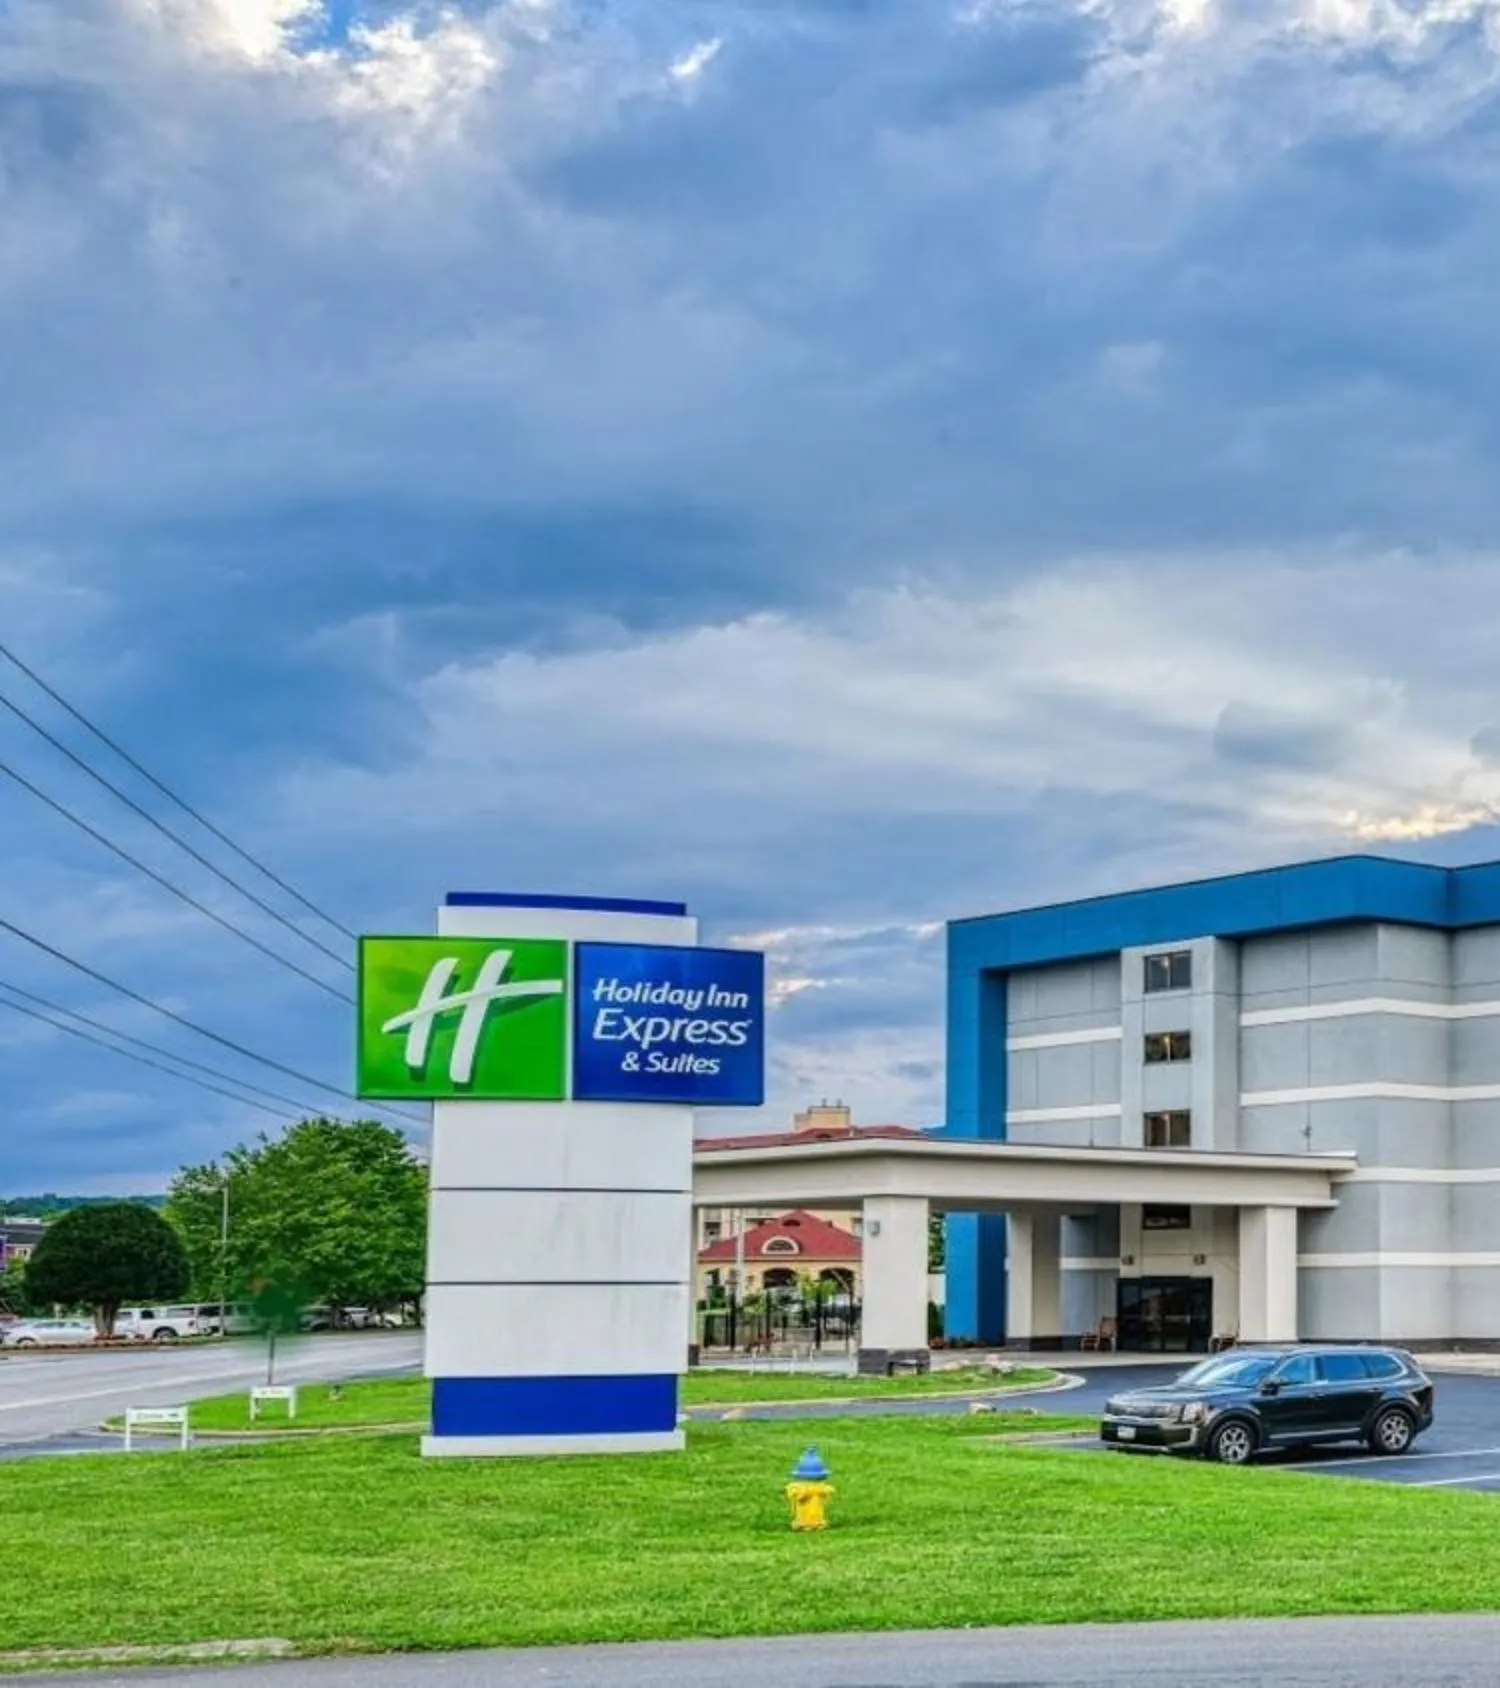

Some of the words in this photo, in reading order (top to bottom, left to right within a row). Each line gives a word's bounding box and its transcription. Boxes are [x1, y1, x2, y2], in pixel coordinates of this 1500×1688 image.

[593, 978, 703, 1011] Holiday
[707, 984, 748, 1008] Inn
[593, 1008, 750, 1050] Express
[621, 1052, 641, 1072] &
[645, 1052, 721, 1075] Suites
